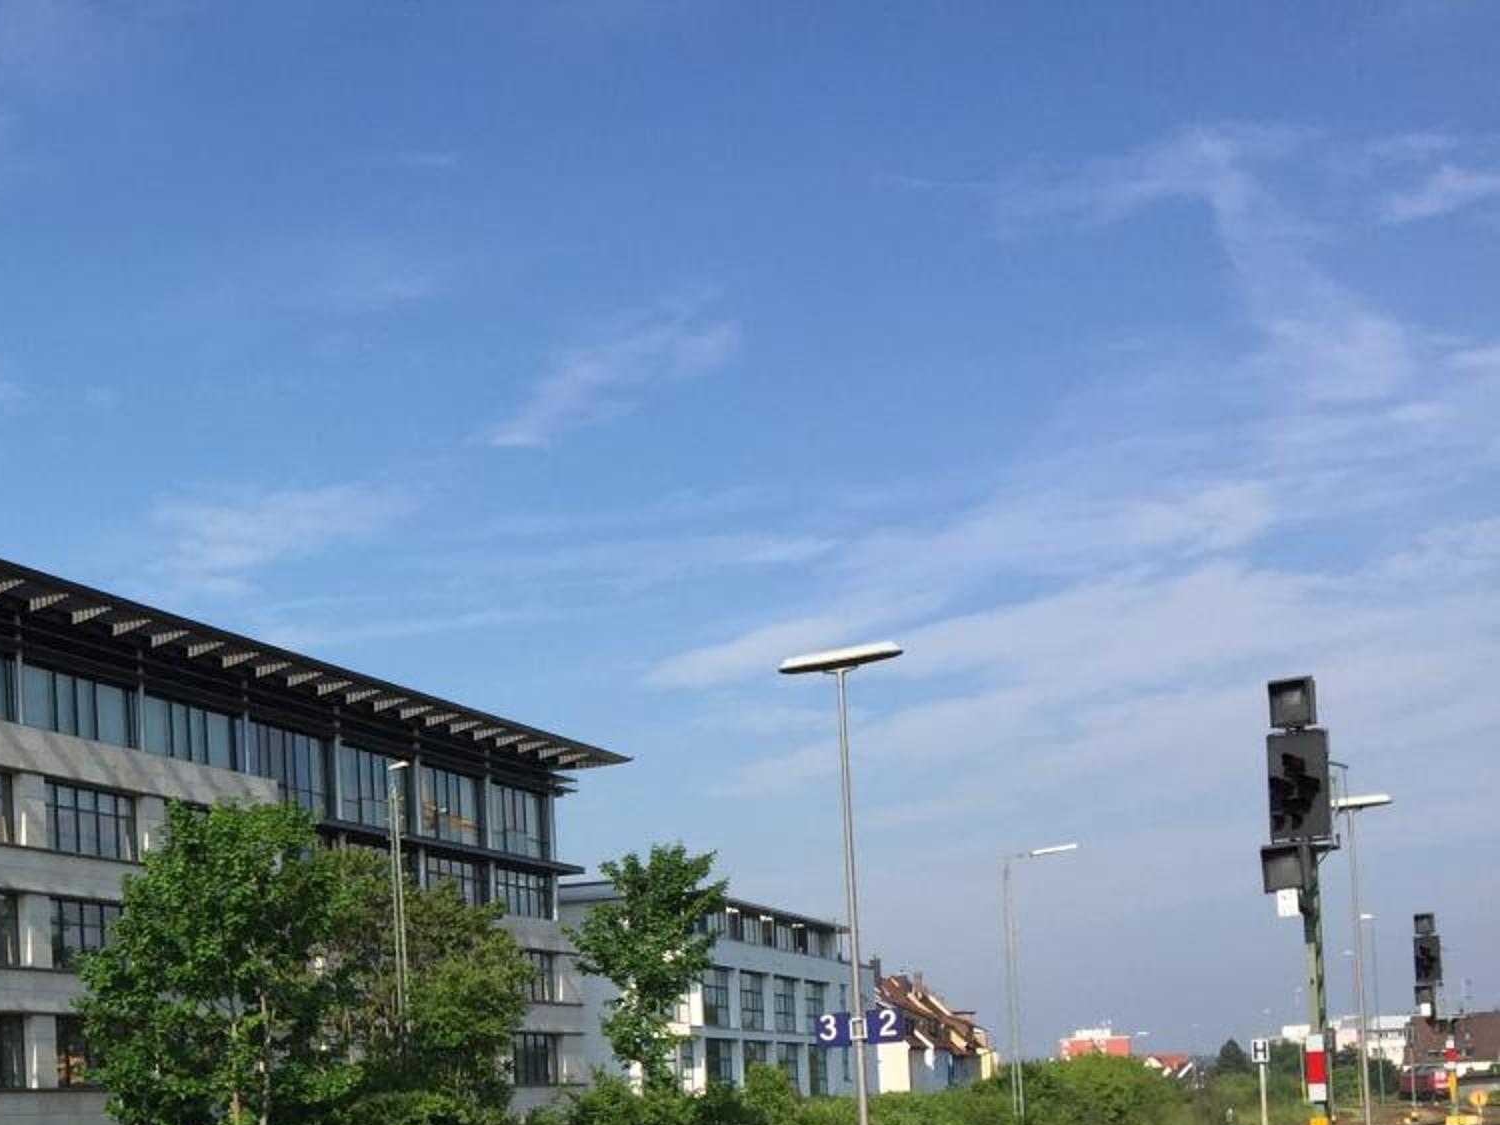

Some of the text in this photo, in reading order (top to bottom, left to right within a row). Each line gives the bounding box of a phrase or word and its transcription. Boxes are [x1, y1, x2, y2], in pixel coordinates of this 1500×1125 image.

[819, 1013, 837, 1041] 3
[879, 1009, 897, 1037] 2
[1253, 1041, 1267, 1059] H
